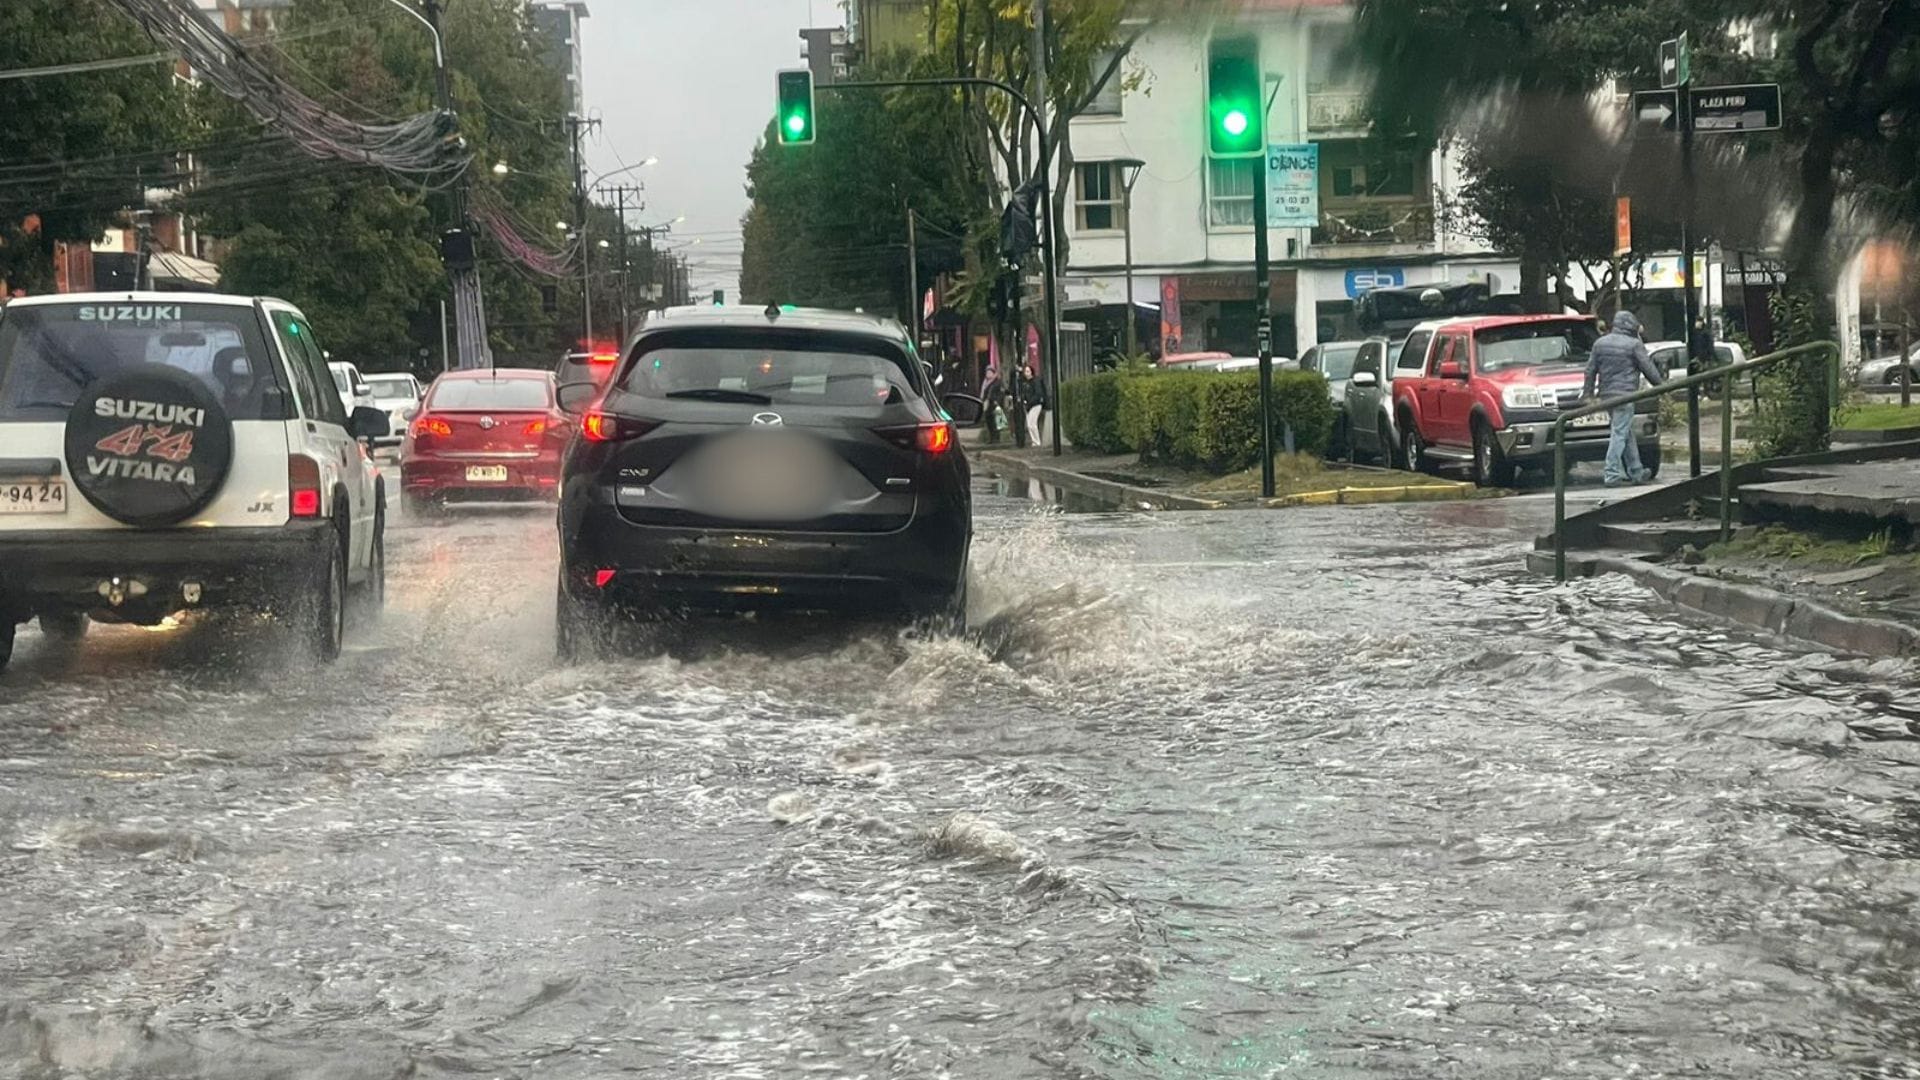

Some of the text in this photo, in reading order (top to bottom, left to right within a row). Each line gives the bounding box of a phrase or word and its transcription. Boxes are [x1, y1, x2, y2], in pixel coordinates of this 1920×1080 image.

[1700, 97, 1725, 108] PLAZA
[1354, 270, 1394, 289] sb
[79, 306, 181, 320] SUZUKI
[95, 397, 205, 427] SUZUKI
[86, 455, 196, 486] VITARA
[247, 502, 274, 512] JX
